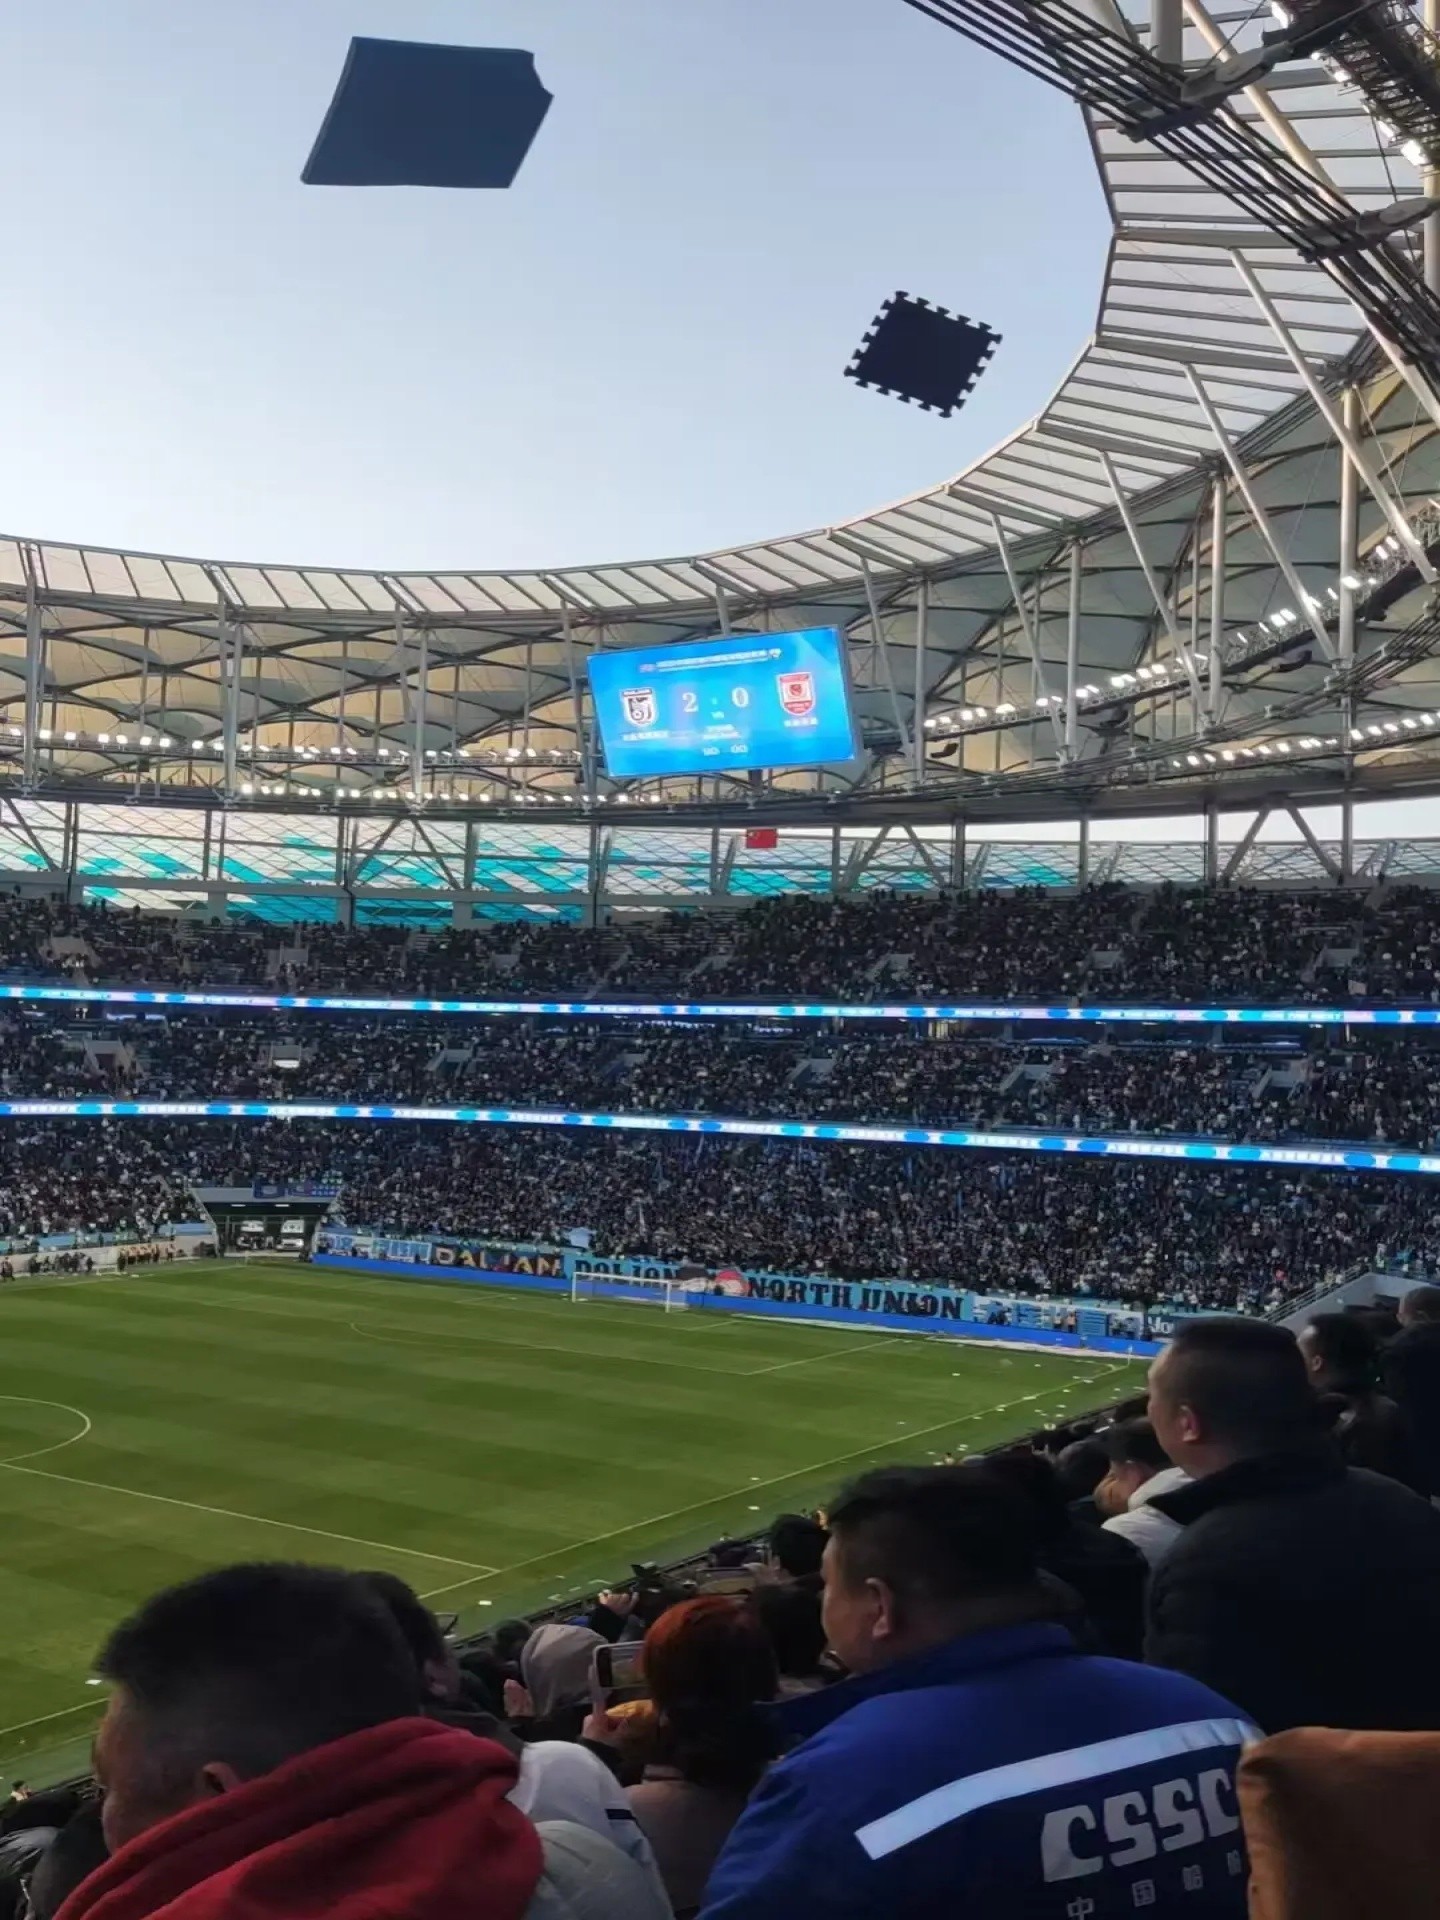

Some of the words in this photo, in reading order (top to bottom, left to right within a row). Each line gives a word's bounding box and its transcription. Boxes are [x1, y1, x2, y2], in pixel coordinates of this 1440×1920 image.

[682, 691, 698, 713] 2
[731, 687, 749, 708] 0
[748, 1276, 851, 1309] NORTH
[859, 1287, 964, 1320] UNION
[1040, 1768, 1240, 1882] CSSC
